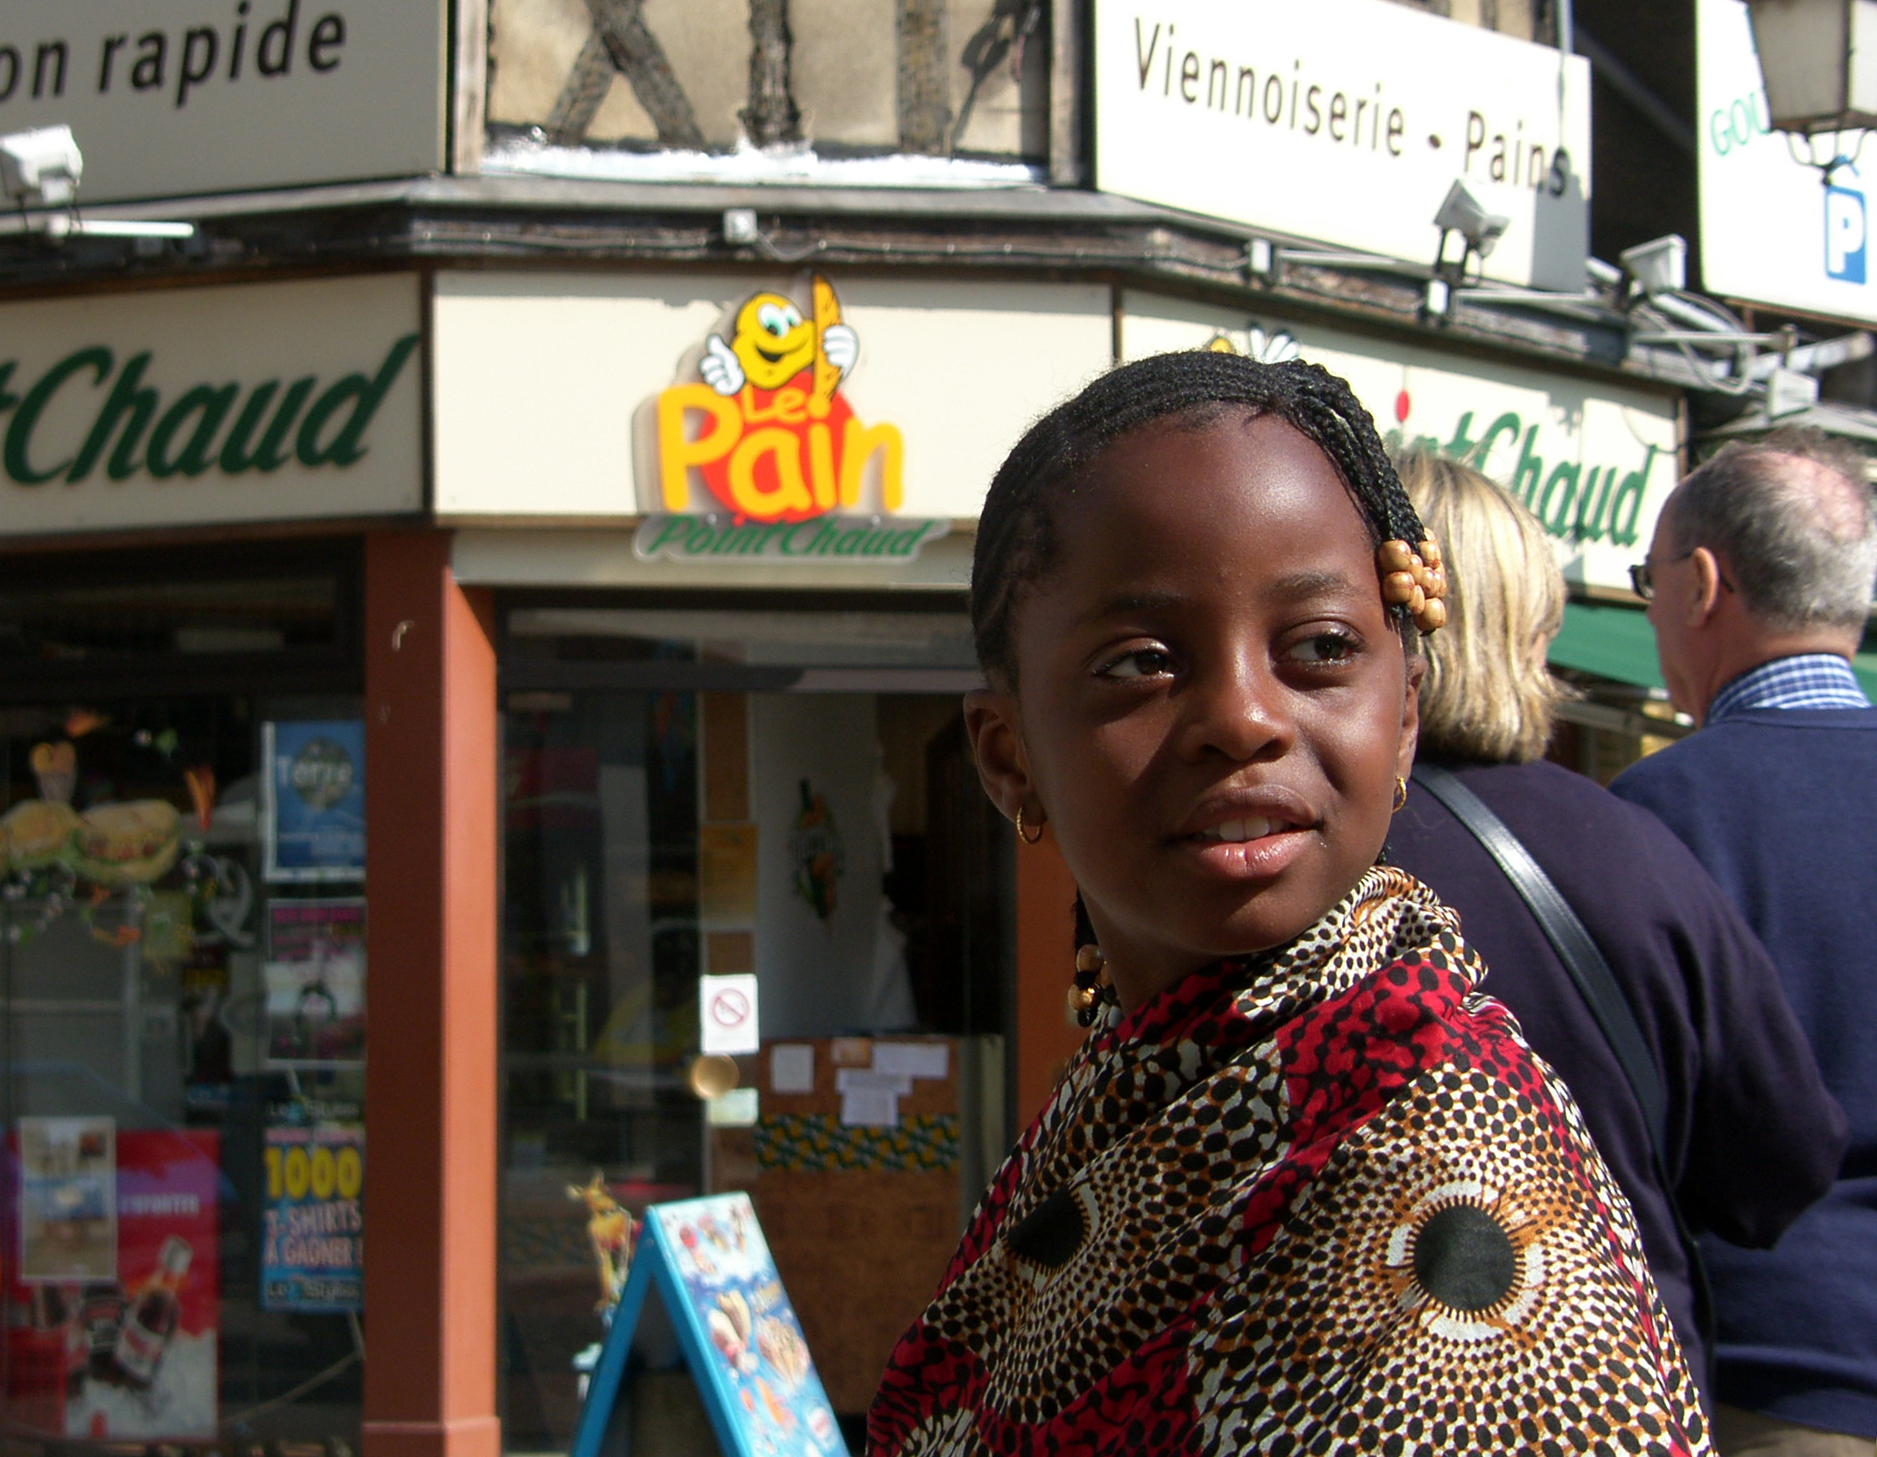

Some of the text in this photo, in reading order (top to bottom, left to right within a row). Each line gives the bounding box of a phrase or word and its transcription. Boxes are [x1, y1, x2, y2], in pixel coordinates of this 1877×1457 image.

[98, 0, 346, 107] rapide
[1134, 16, 1570, 197] Viennoiserie Pains
[4, 332, 419, 486] Chaud
[741, 384, 809, 424] Le
[657, 382, 904, 517] Pain
[1475, 411, 1657, 548] Chaud
[648, 512, 938, 557] Point Chaud
[263, 1145, 363, 1200] 1000
[264, 1199, 362, 1238] T-SHIRTS
[283, 1236, 353, 1268] GAGNER
